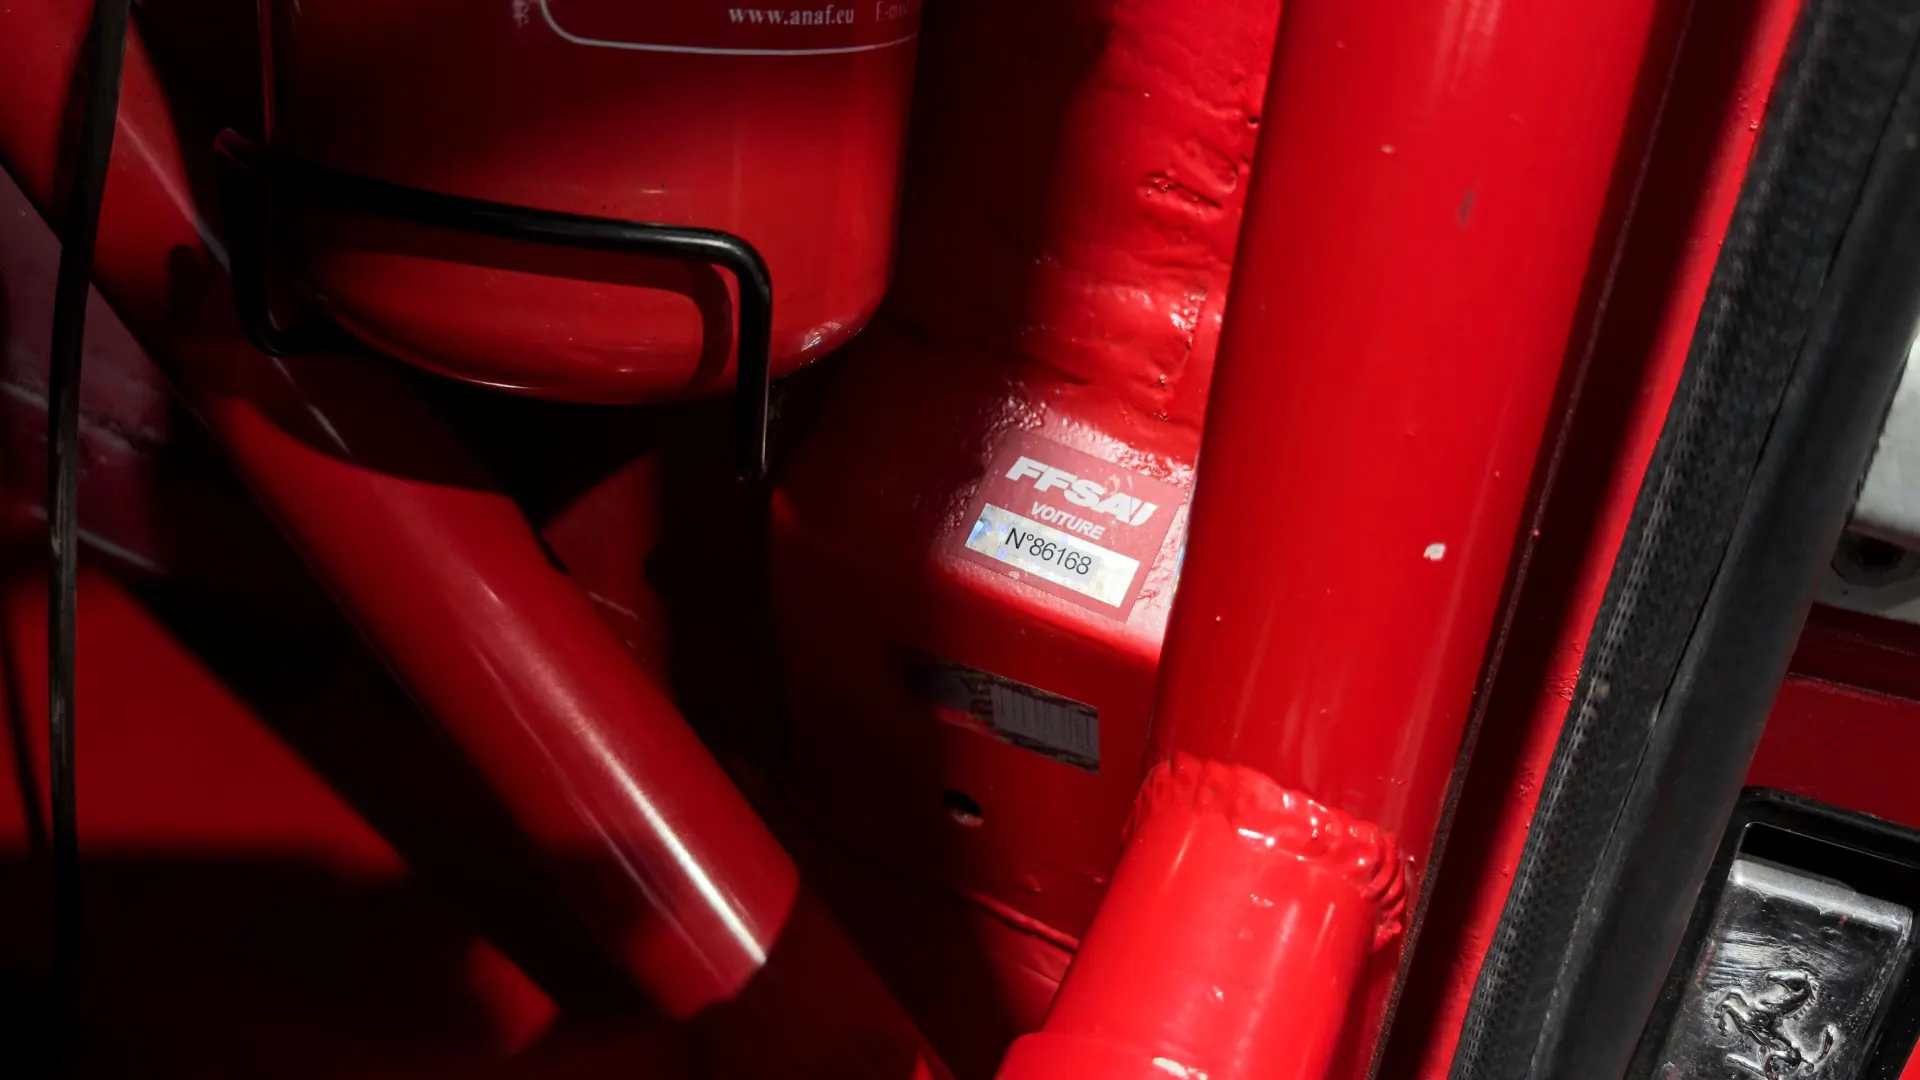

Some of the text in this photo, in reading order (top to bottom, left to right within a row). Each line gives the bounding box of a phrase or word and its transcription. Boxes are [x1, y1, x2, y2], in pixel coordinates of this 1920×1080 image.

[728, 4, 854, 26] www.anaf.eu
[1031, 501, 1105, 540] VOITURE
[1005, 528, 1092, 575] N°86168
